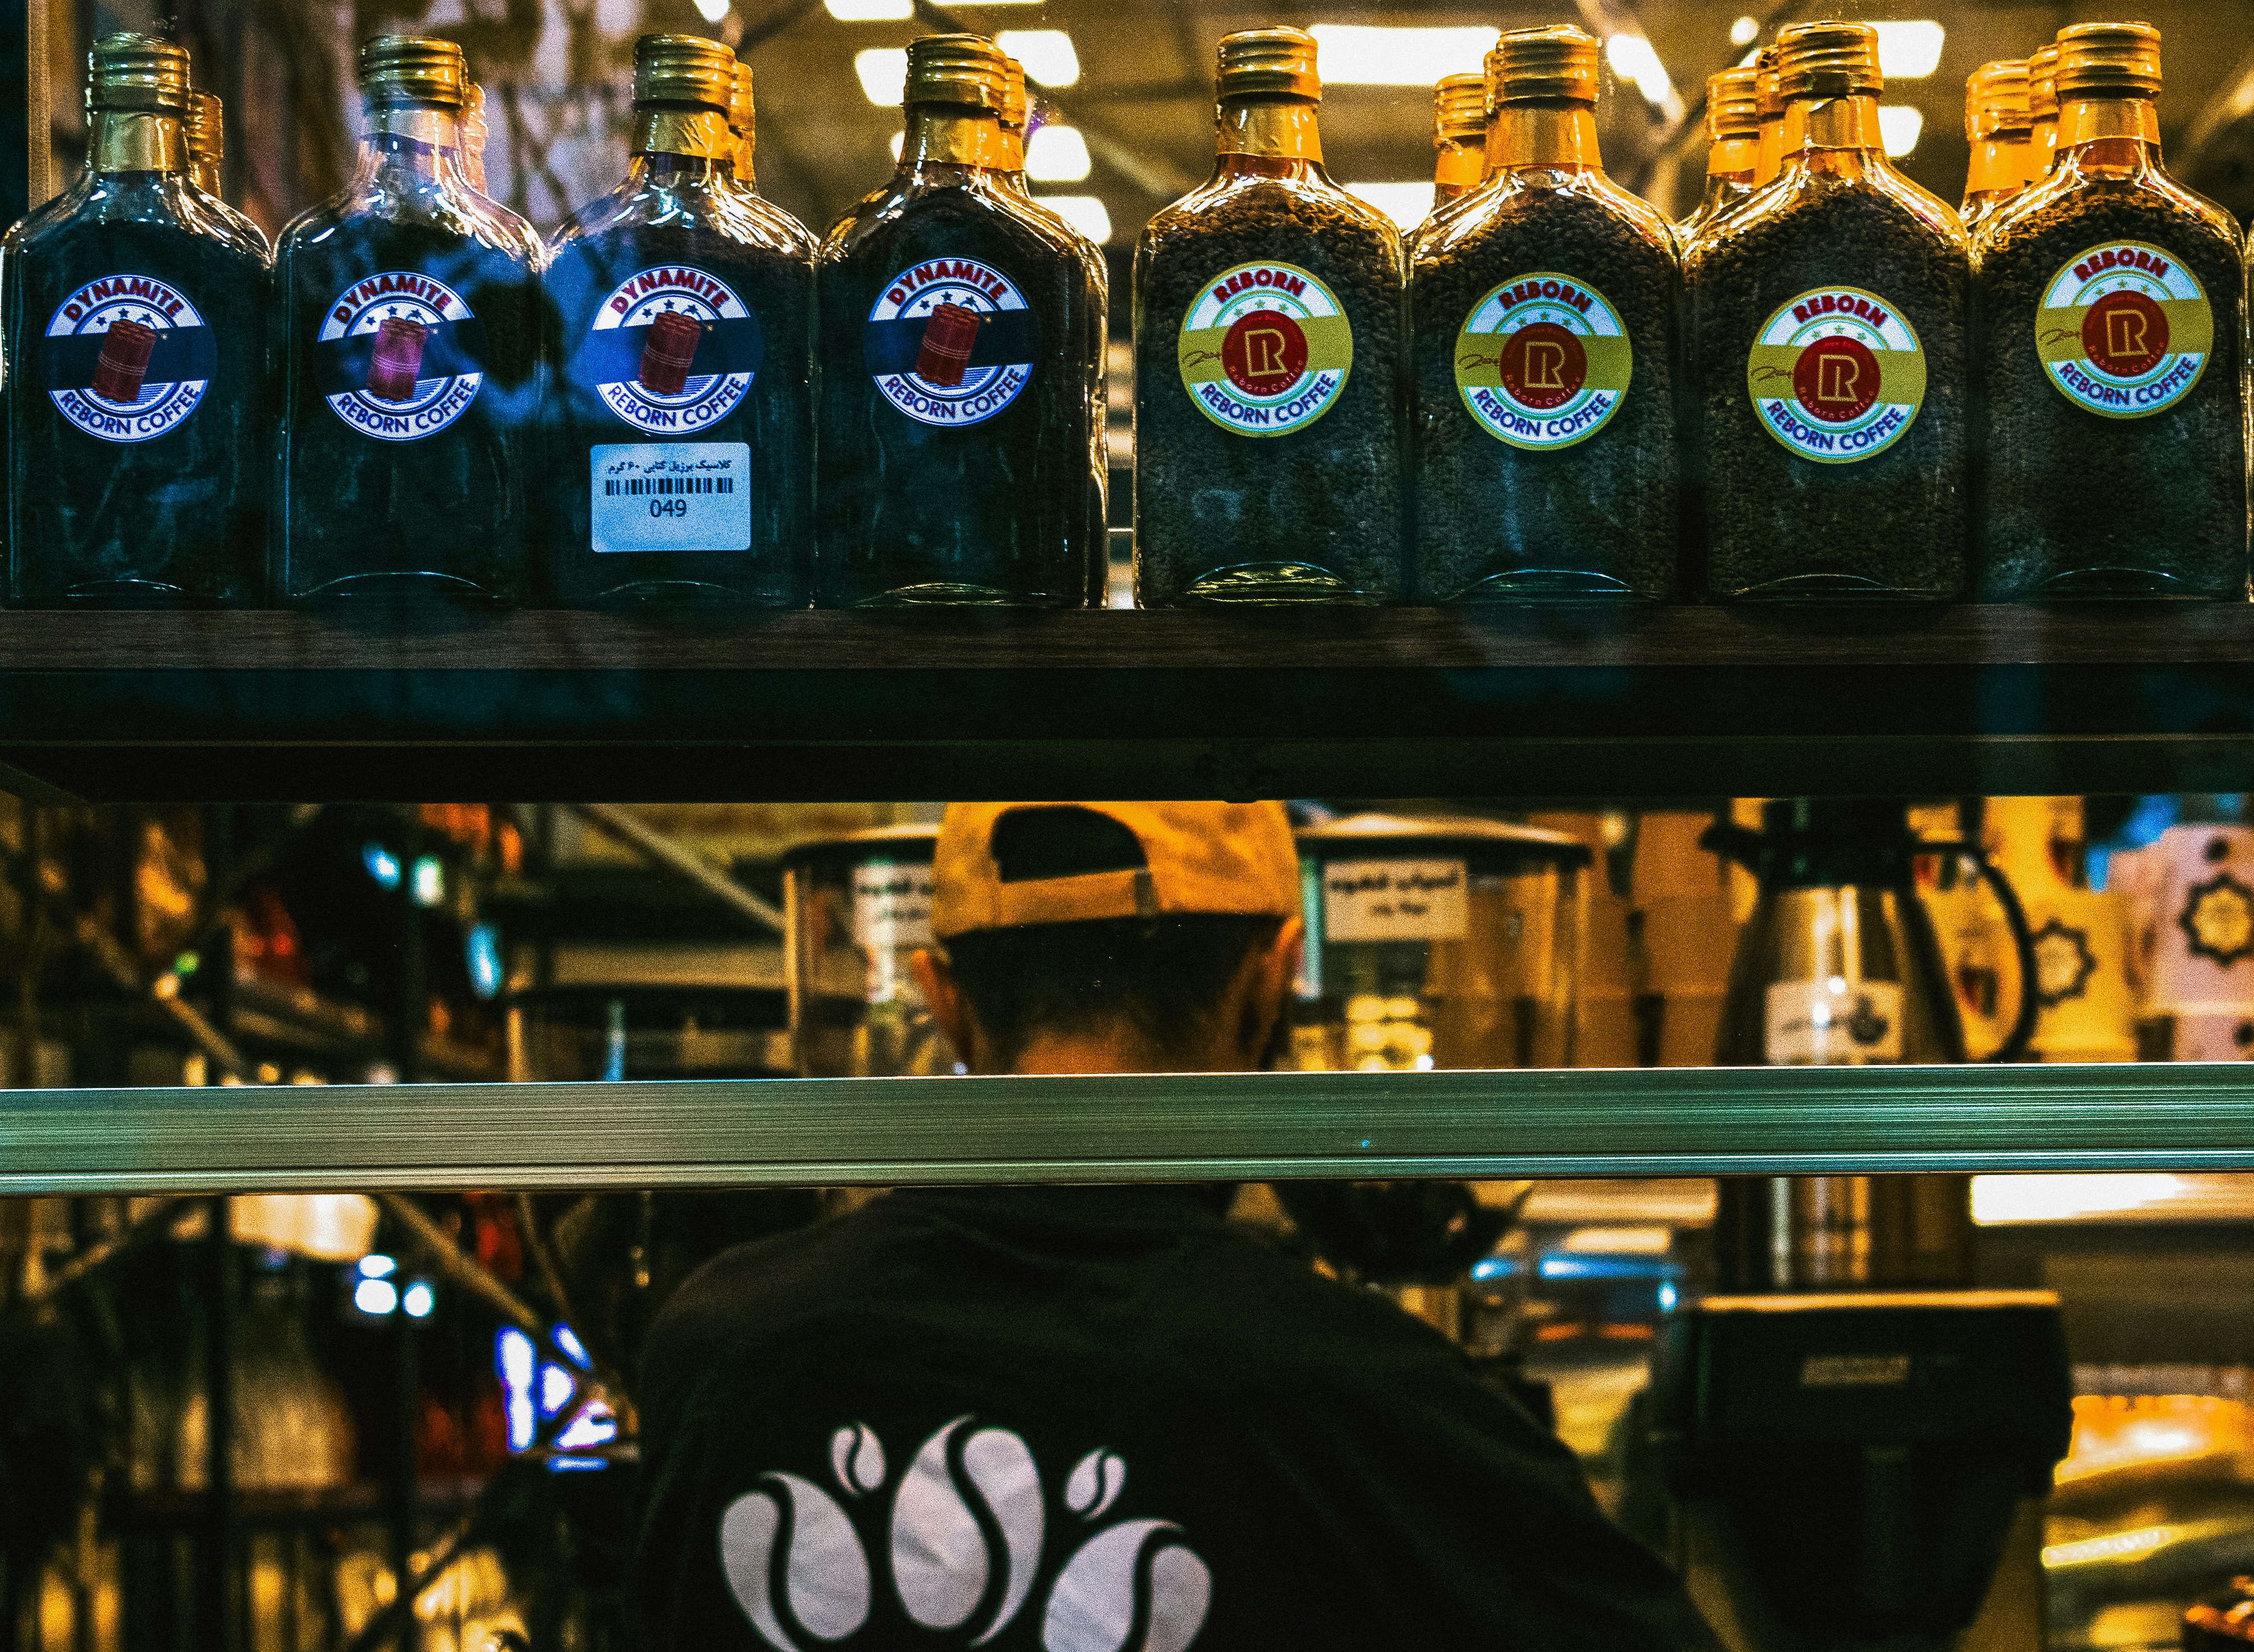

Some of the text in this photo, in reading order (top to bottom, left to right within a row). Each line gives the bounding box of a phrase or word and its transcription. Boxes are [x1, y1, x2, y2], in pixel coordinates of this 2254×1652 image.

[886, 261, 1007, 306] DYNAMITE
[1213, 269, 1307, 303] REBORN
[2073, 249, 2169, 282] REBORN
[63, 278, 184, 322] DYNAMITE
[334, 276, 452, 324] DYNAMITE
[610, 269, 730, 315] DYNAMITE
[1499, 281, 1593, 313] REBORN
[1793, 295, 1888, 328] REBORN
[608, 377, 745, 427] REBORN COFFEE
[885, 368, 1025, 418] REBORN COFFEE
[1201, 374, 1335, 424] REBORN COFFEE
[2059, 357, 2197, 405] REBORN COFFEE
[61, 384, 196, 434] REBORN COFFEE
[338, 379, 475, 433] REBORN COFFEE
[1473, 389, 1611, 437] REBORN COFFEE
[1767, 401, 1905, 450] REBORN COFFEE
[650, 499, 687, 518] 049
